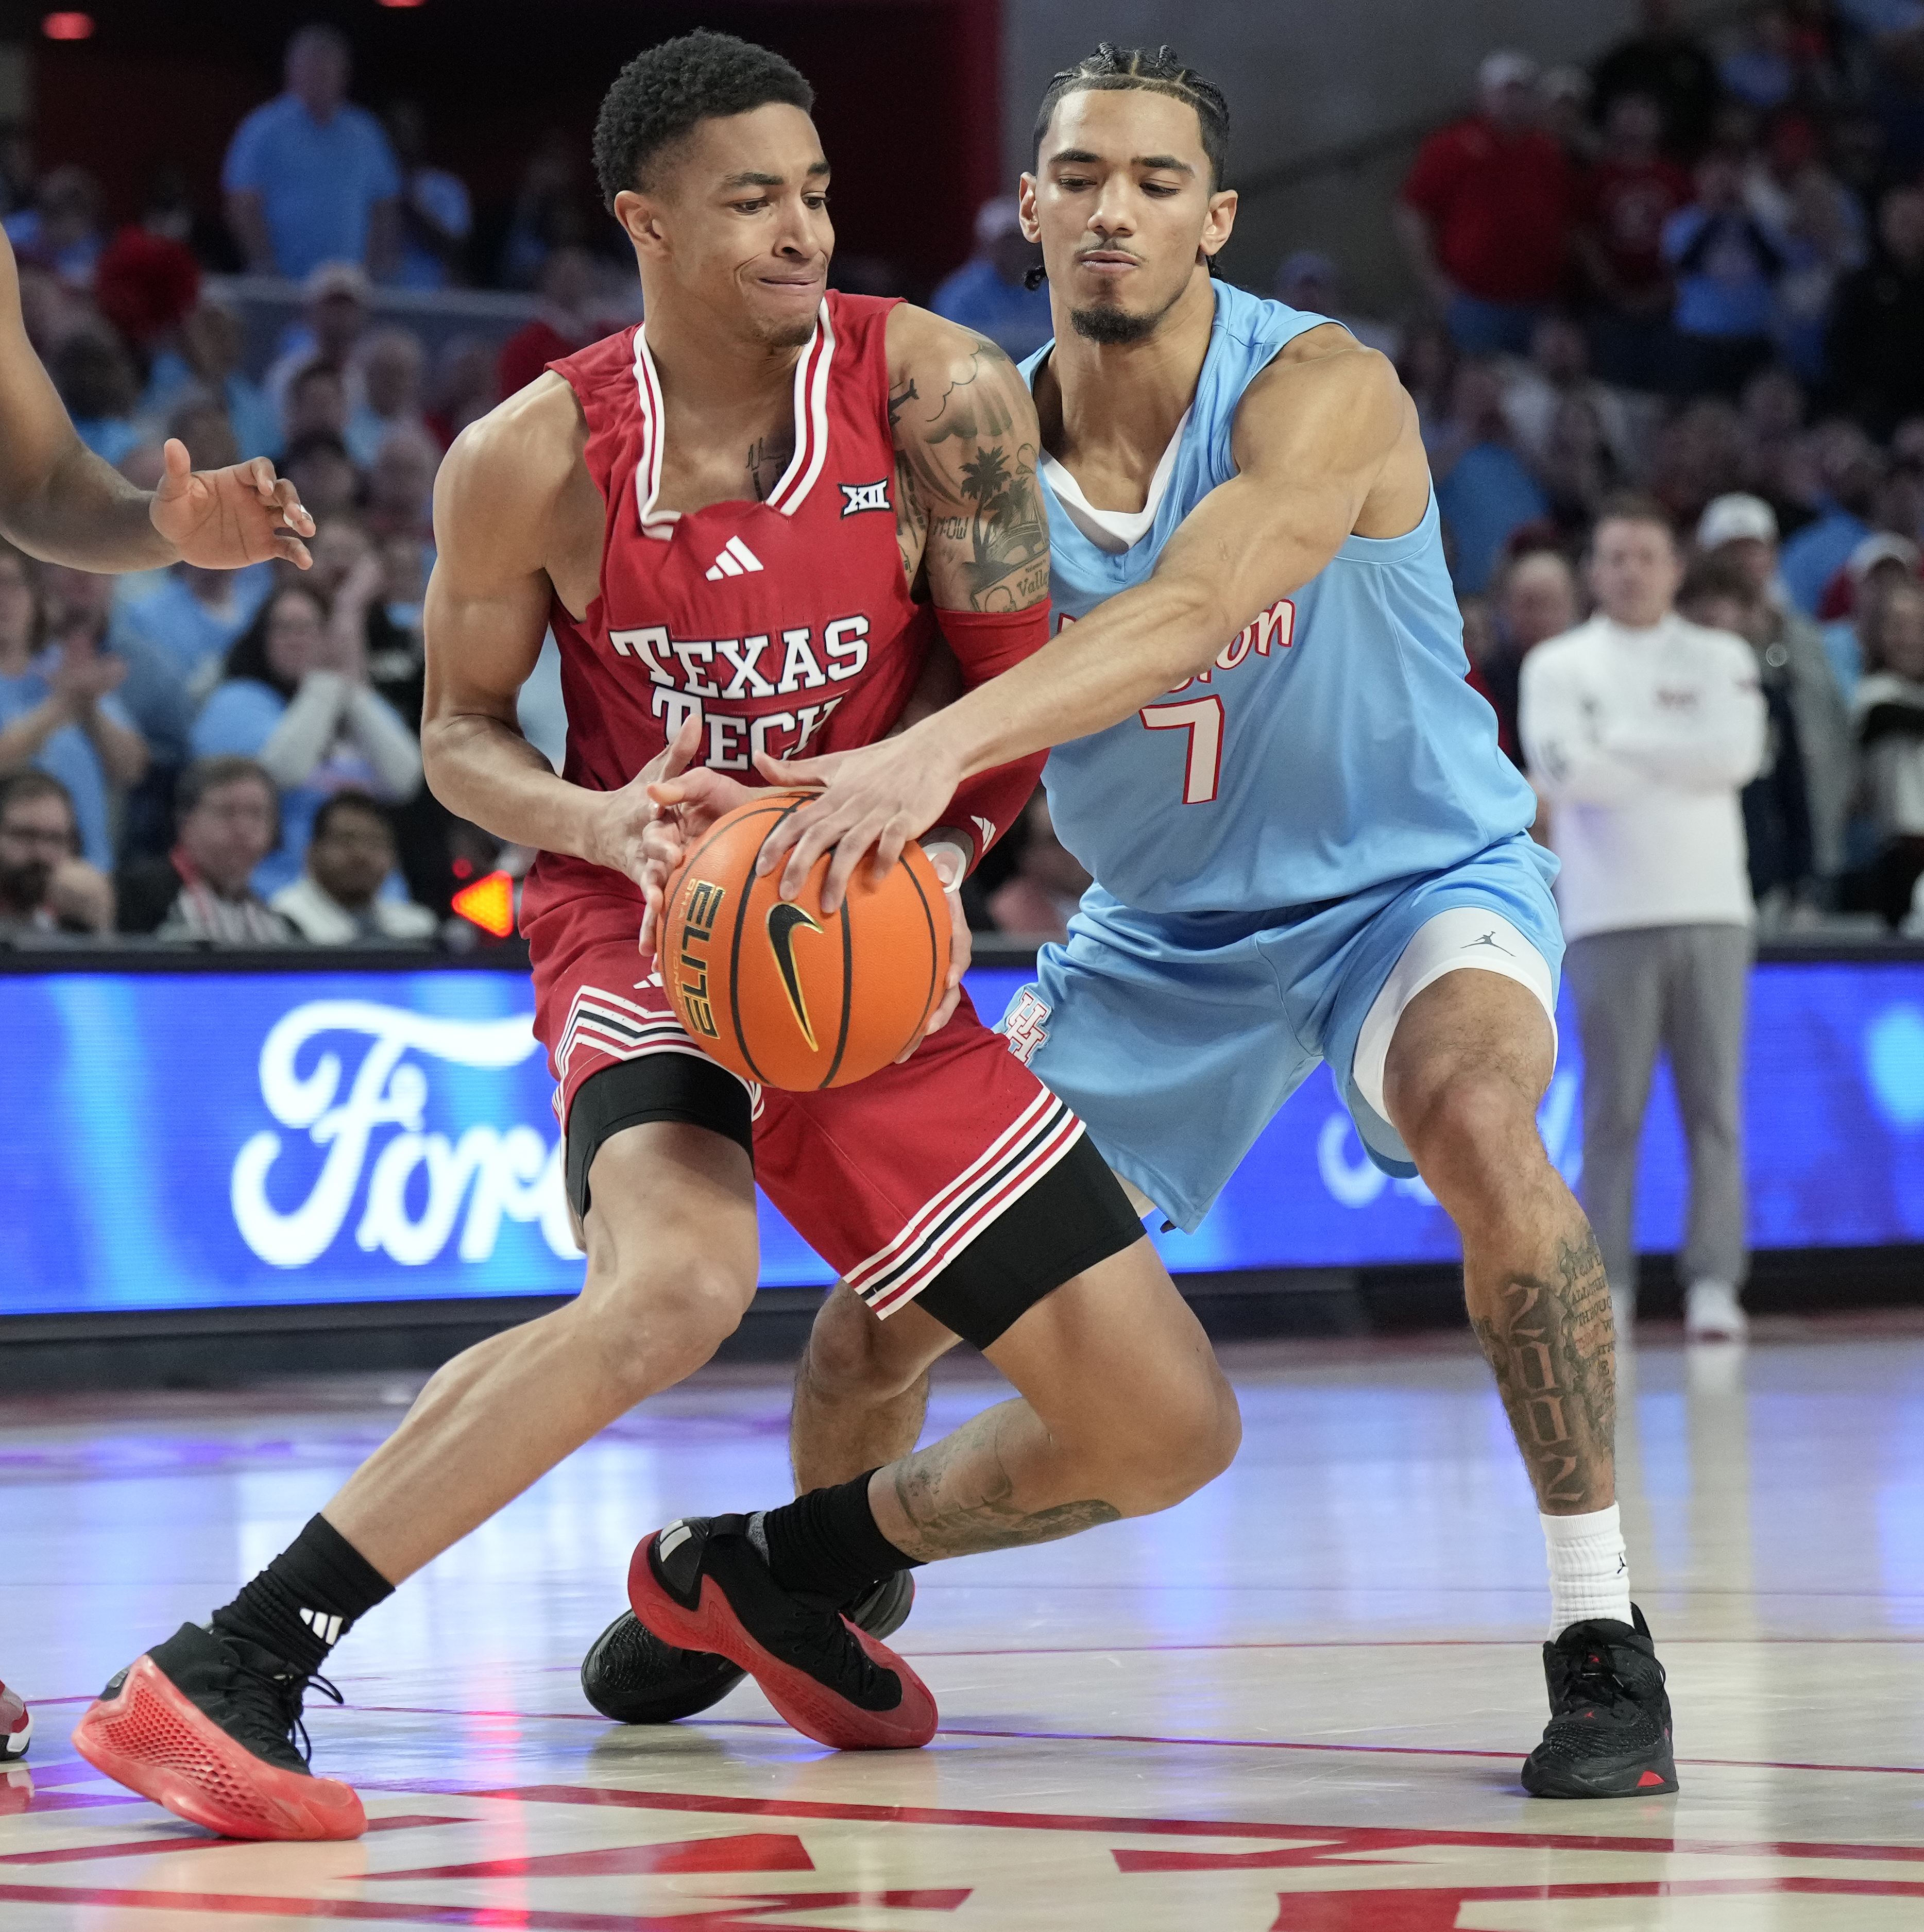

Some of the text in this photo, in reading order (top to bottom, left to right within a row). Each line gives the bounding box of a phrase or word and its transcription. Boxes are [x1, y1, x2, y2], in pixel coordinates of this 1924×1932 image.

[839, 478, 892, 518] XII
[609, 615, 870, 700] TEXAS
[1138, 694, 1225, 805] 7
[680, 879, 726, 1039] ELITE
